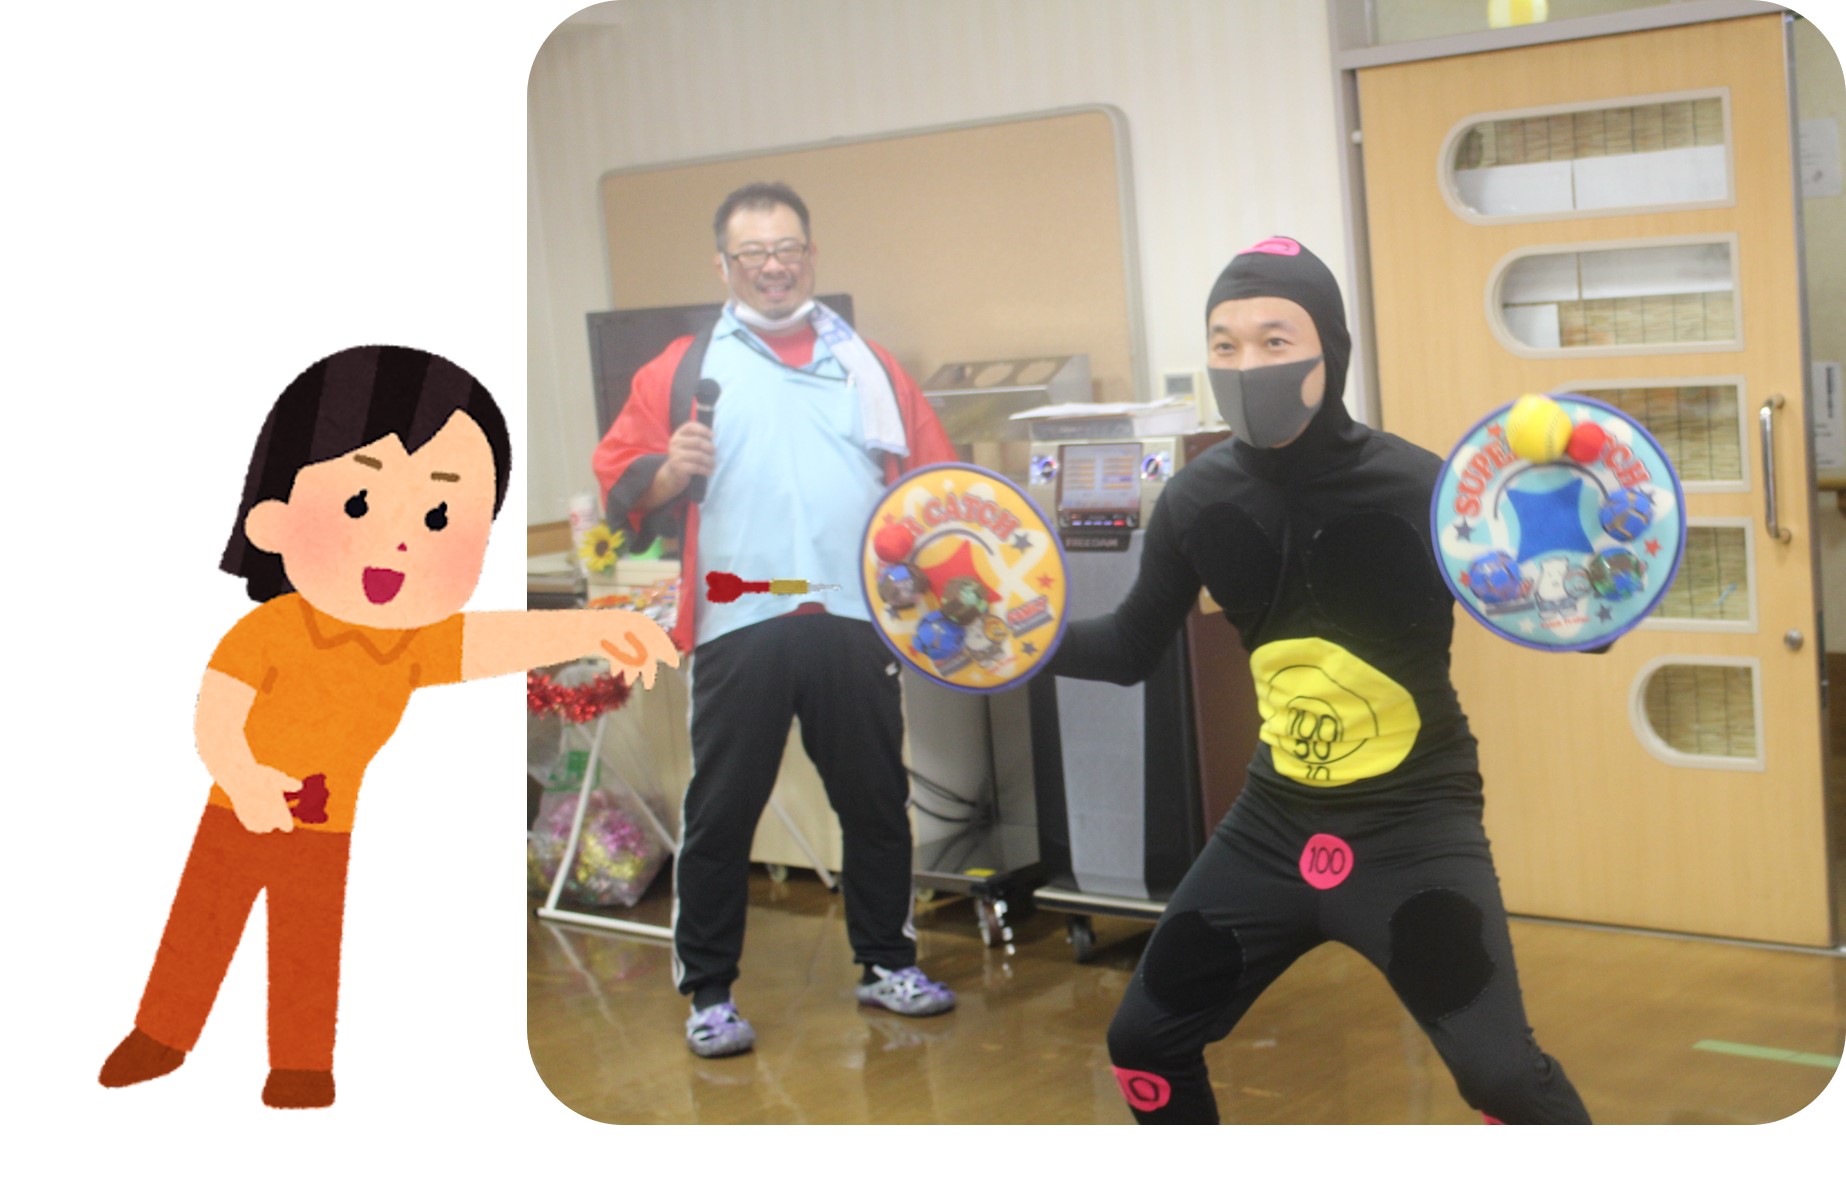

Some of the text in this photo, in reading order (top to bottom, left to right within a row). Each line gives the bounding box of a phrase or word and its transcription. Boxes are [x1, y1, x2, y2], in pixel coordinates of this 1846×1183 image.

[1454, 436, 1520, 517] SUPE
[923, 491, 1021, 541] CATCH
[1289, 706, 1338, 743] 100
[1293, 738, 1332, 760] 50
[1308, 846, 1346, 875] 100
